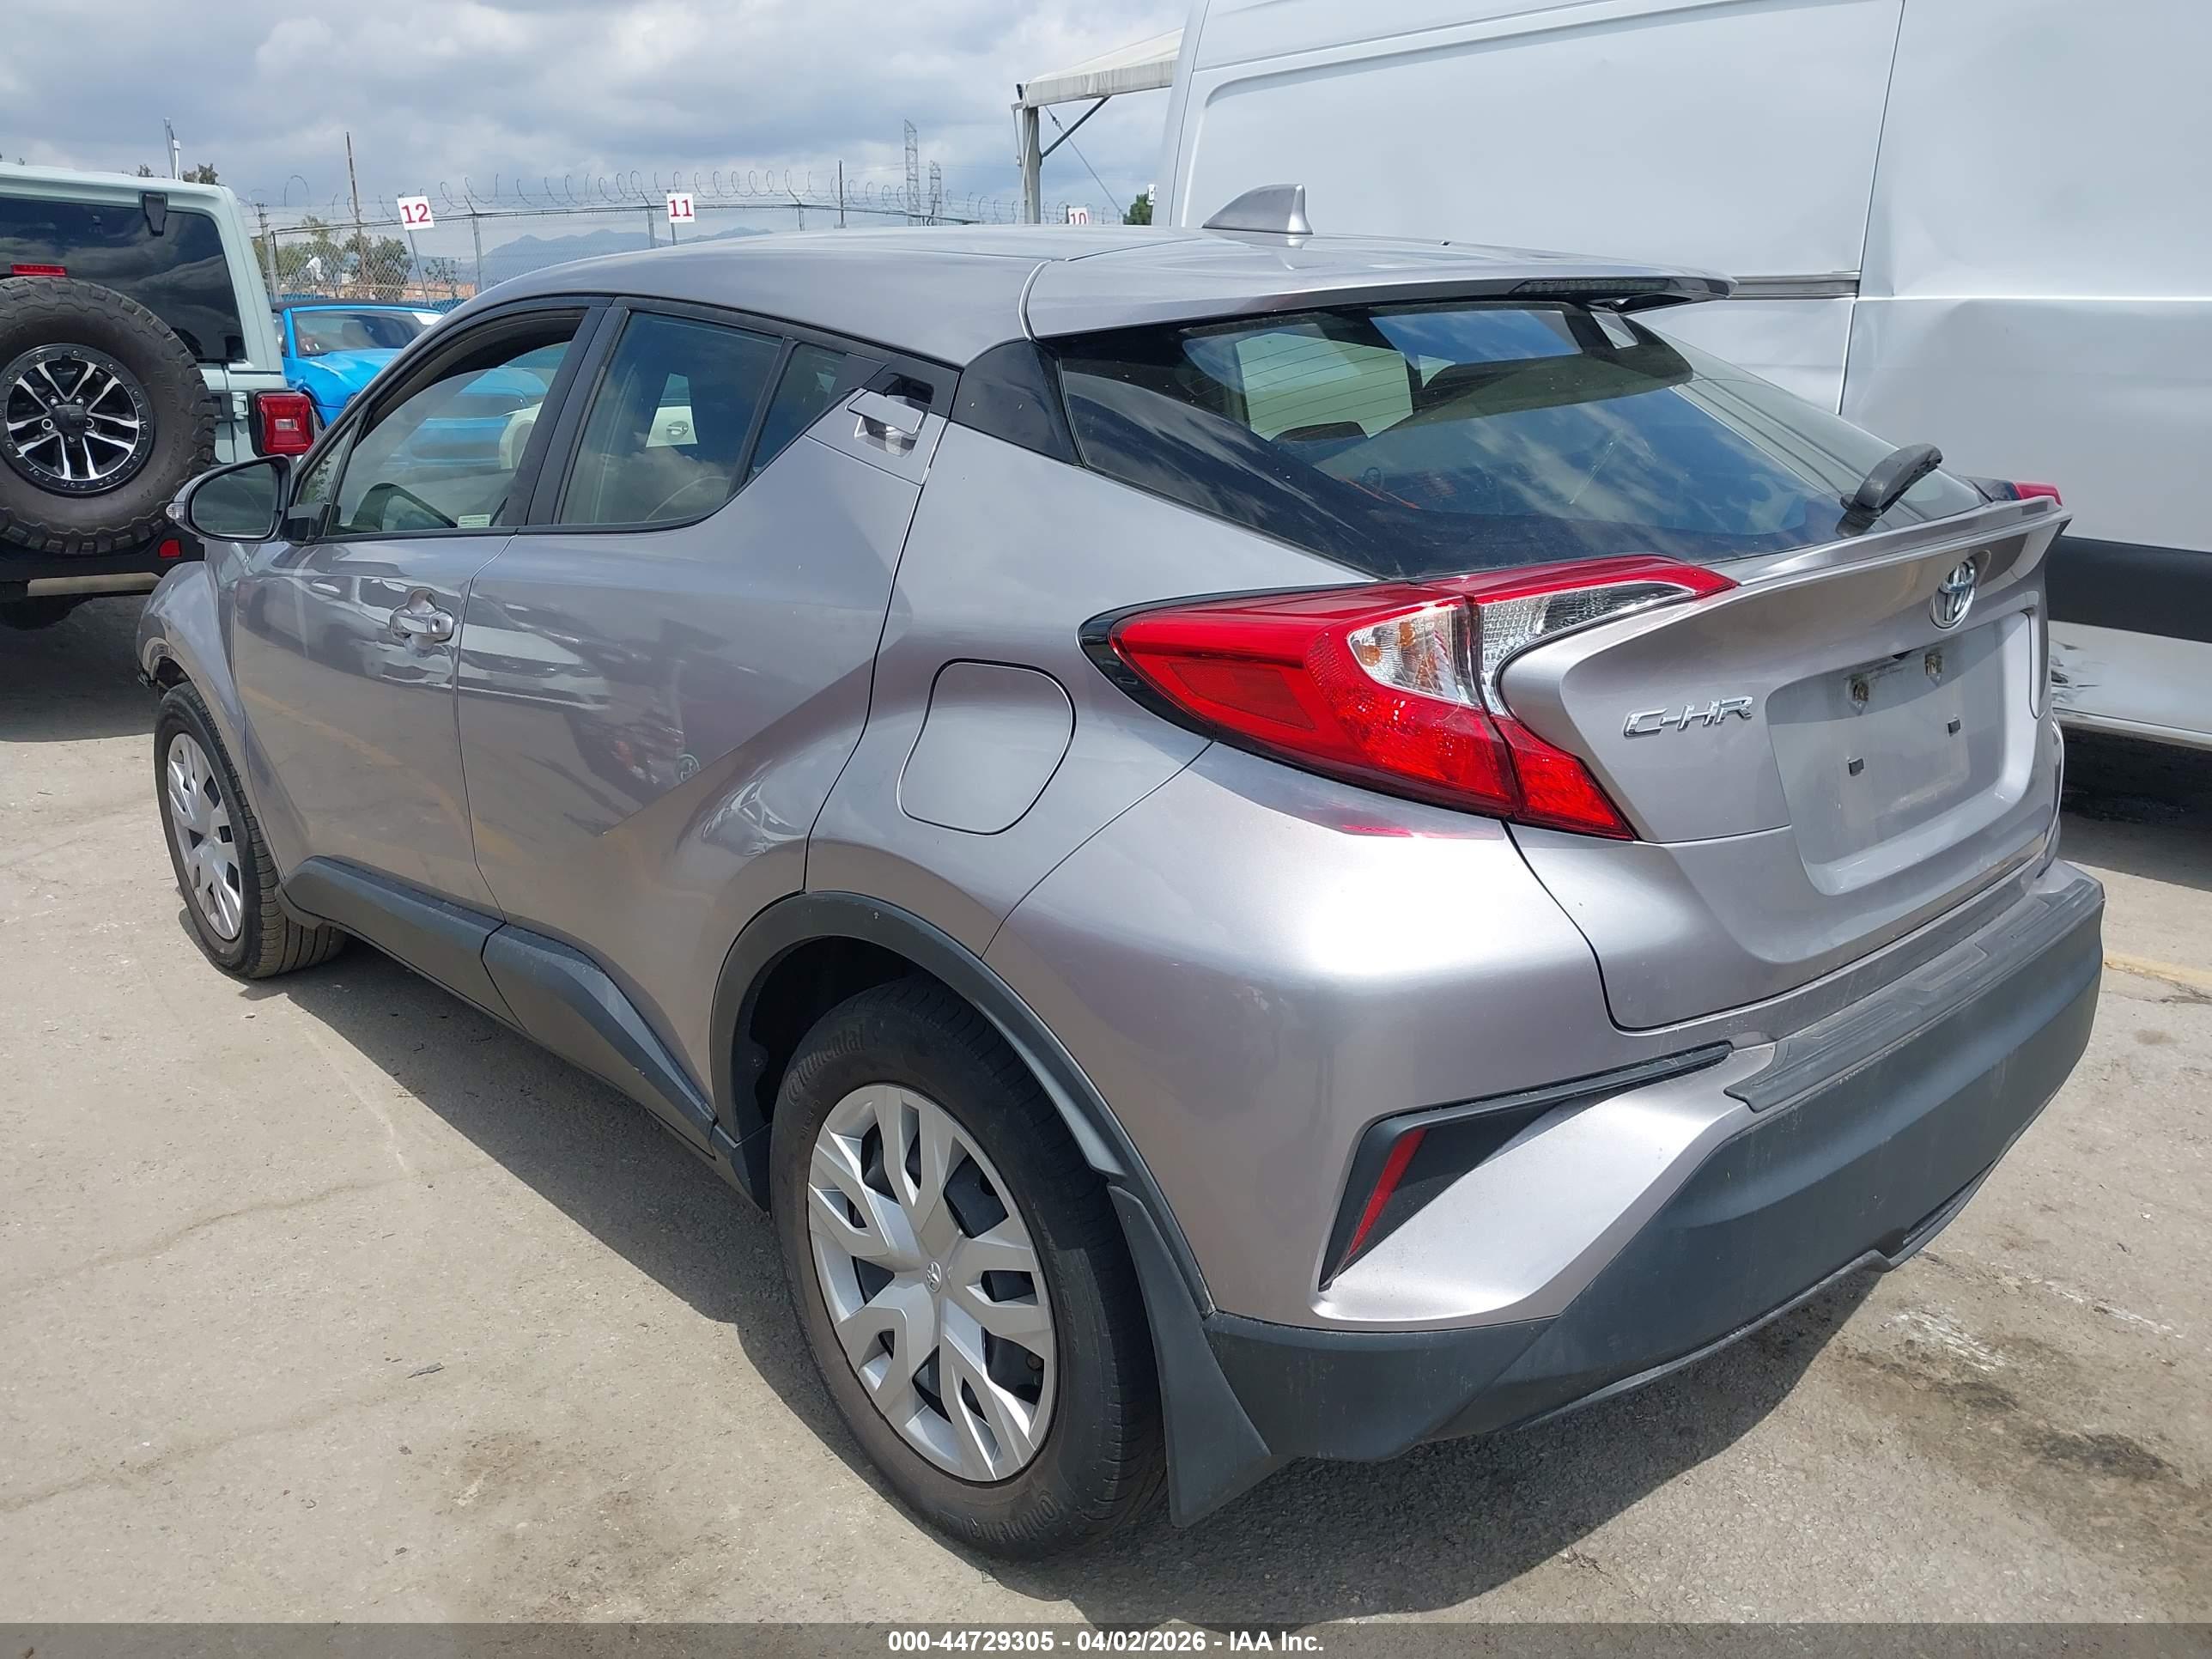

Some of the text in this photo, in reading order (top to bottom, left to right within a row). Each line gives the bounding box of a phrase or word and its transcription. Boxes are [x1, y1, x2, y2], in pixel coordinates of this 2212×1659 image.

[401, 204, 431, 223] 12
[669, 198, 693, 216] 11
[1624, 696, 1753, 737] C-HR
